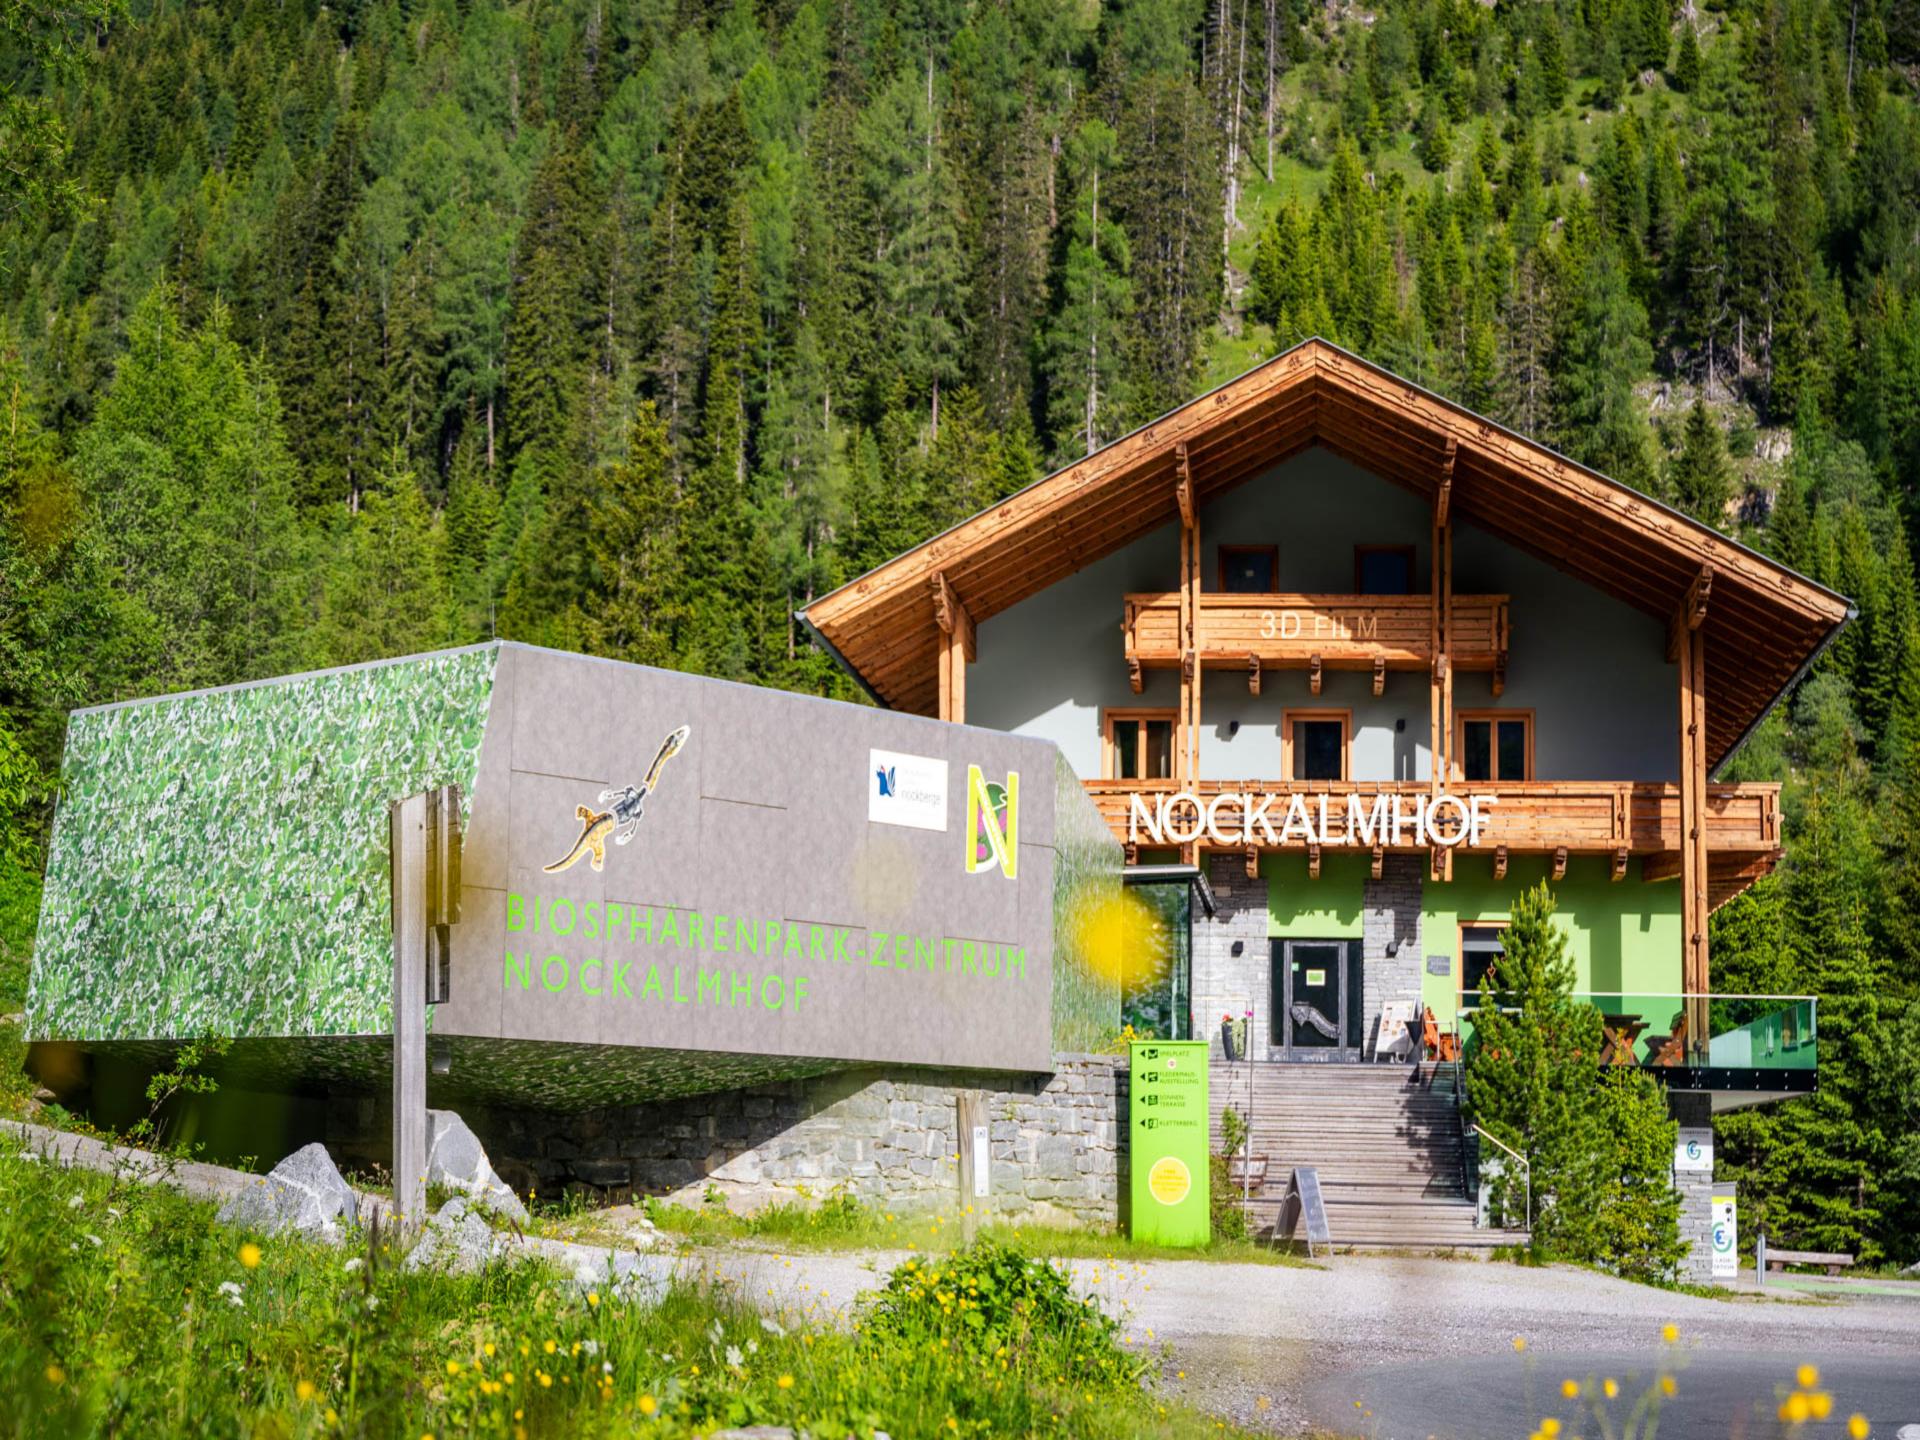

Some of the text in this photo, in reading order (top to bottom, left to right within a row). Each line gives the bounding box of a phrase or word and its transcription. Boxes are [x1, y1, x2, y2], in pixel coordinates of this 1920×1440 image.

[1260, 610, 1377, 639] 3D FILM
[1128, 792, 1499, 847] NOCKALMHOF
[506, 893, 1028, 980] BIOSPHÄRENPARK-ZENTRUM
[503, 951, 811, 1012] NOCKALMHOF
